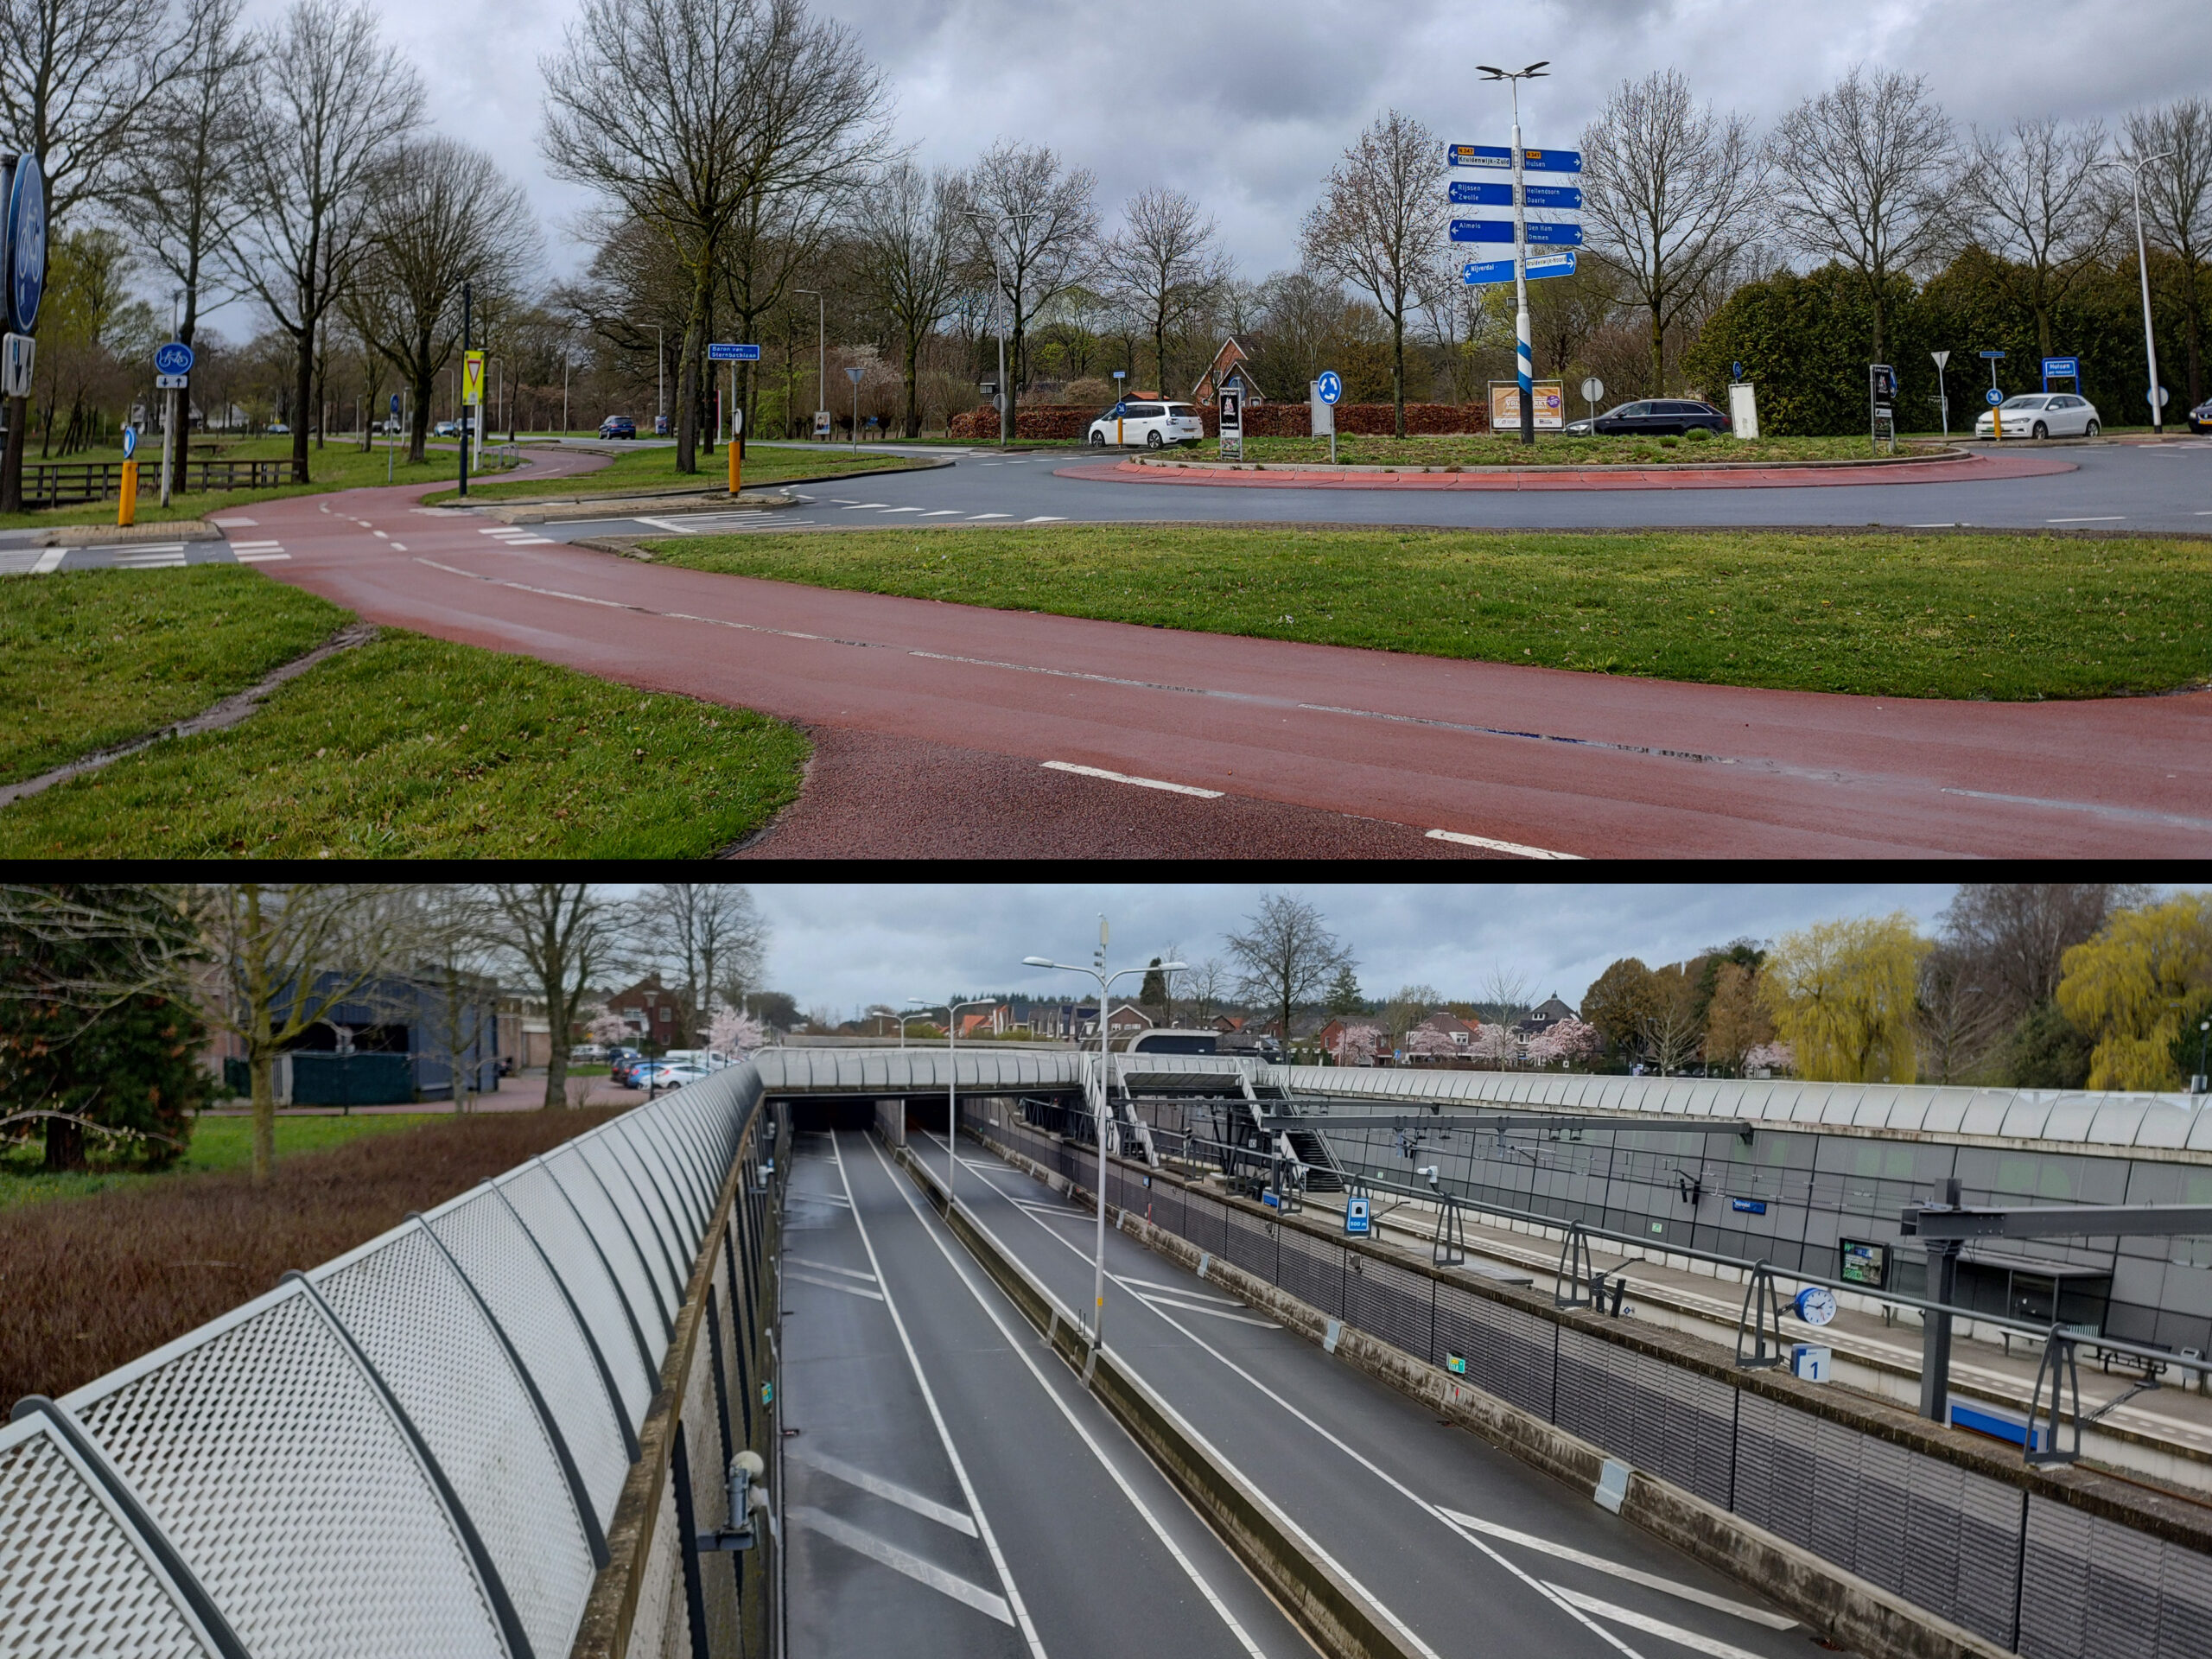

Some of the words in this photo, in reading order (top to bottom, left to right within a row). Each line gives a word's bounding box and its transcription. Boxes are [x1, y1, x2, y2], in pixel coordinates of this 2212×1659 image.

[1459, 156, 1510, 165] Kruidenwijk-Zuid
[1458, 183, 1481, 193] Rijssen
[1458, 193, 1479, 201] Zwolle
[1471, 264, 1495, 273] Nijverdal
[1810, 1361, 1819, 1380] 1
